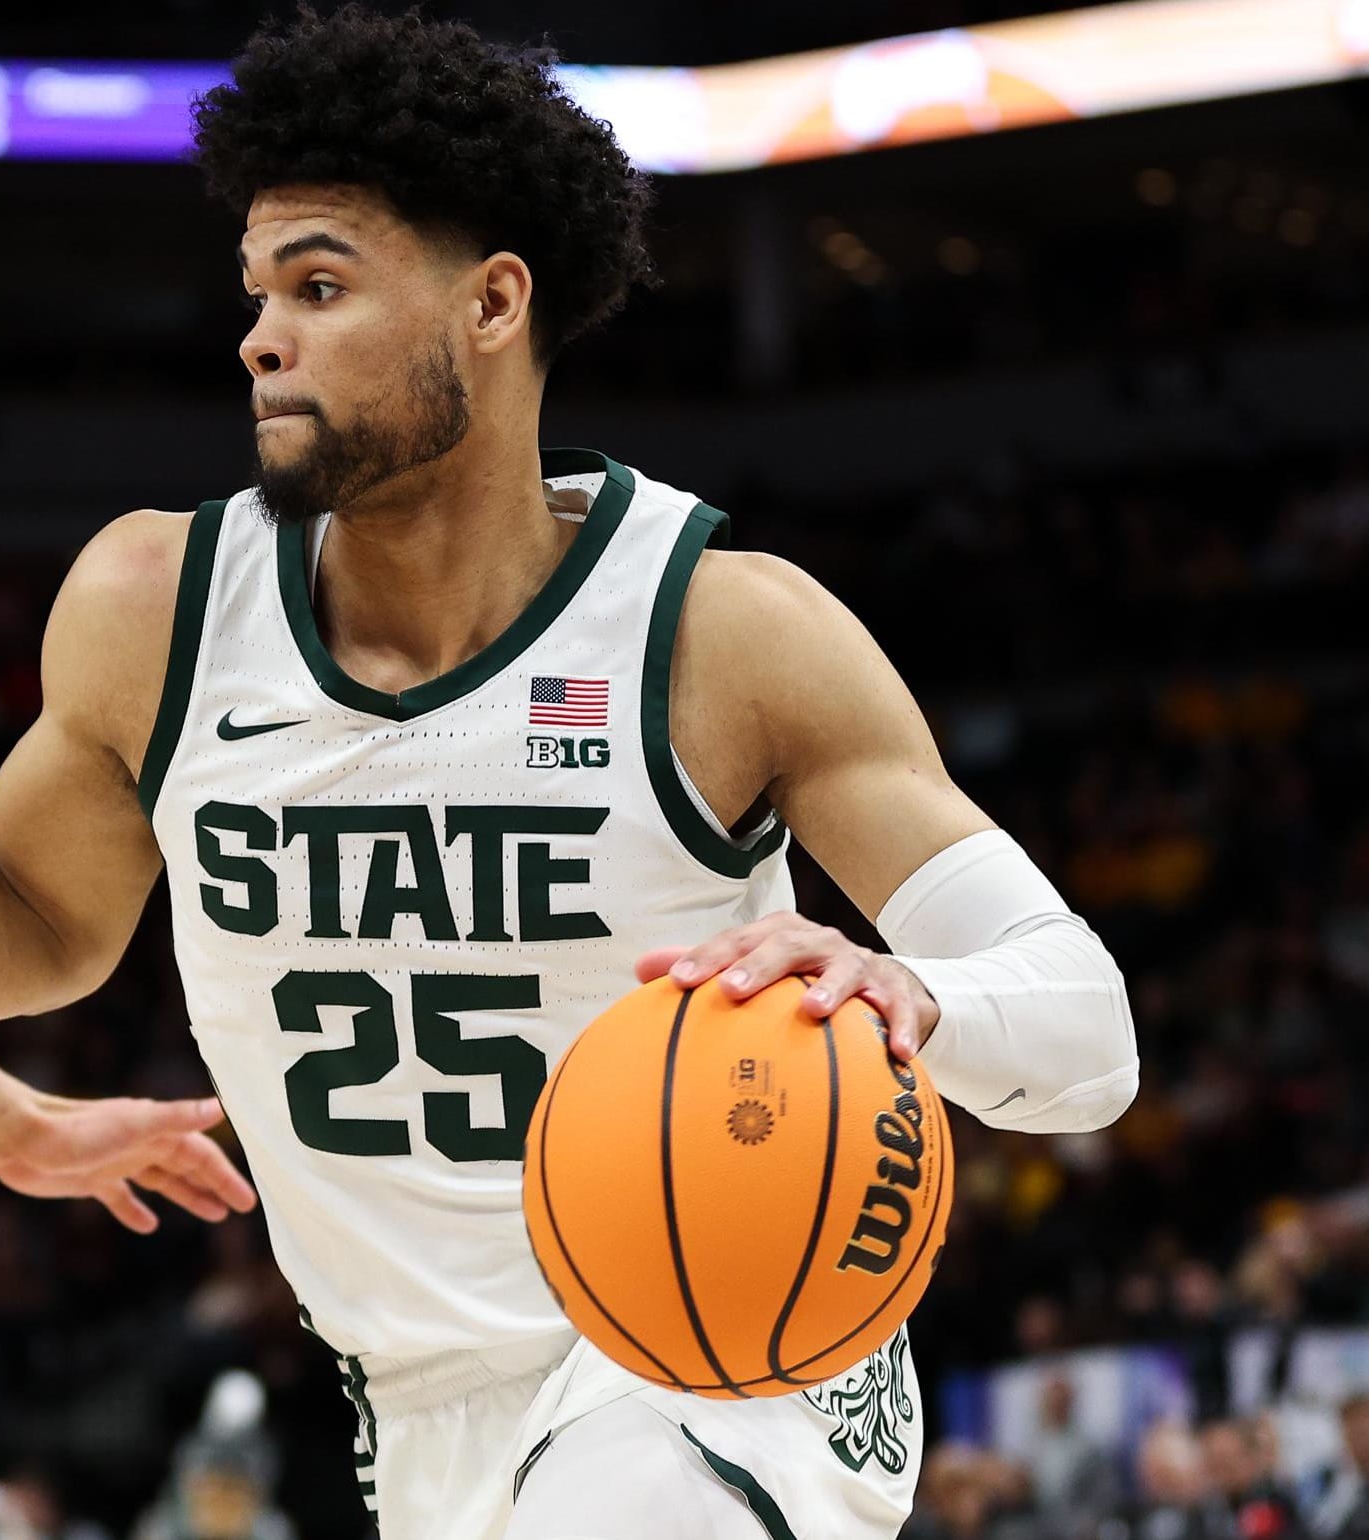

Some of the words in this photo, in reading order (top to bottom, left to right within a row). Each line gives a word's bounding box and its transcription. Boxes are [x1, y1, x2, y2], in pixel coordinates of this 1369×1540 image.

[526, 736, 612, 769] B1G
[193, 800, 613, 943] STATE
[271, 969, 548, 1163] 25
[834, 1009, 926, 1276] Wilso
